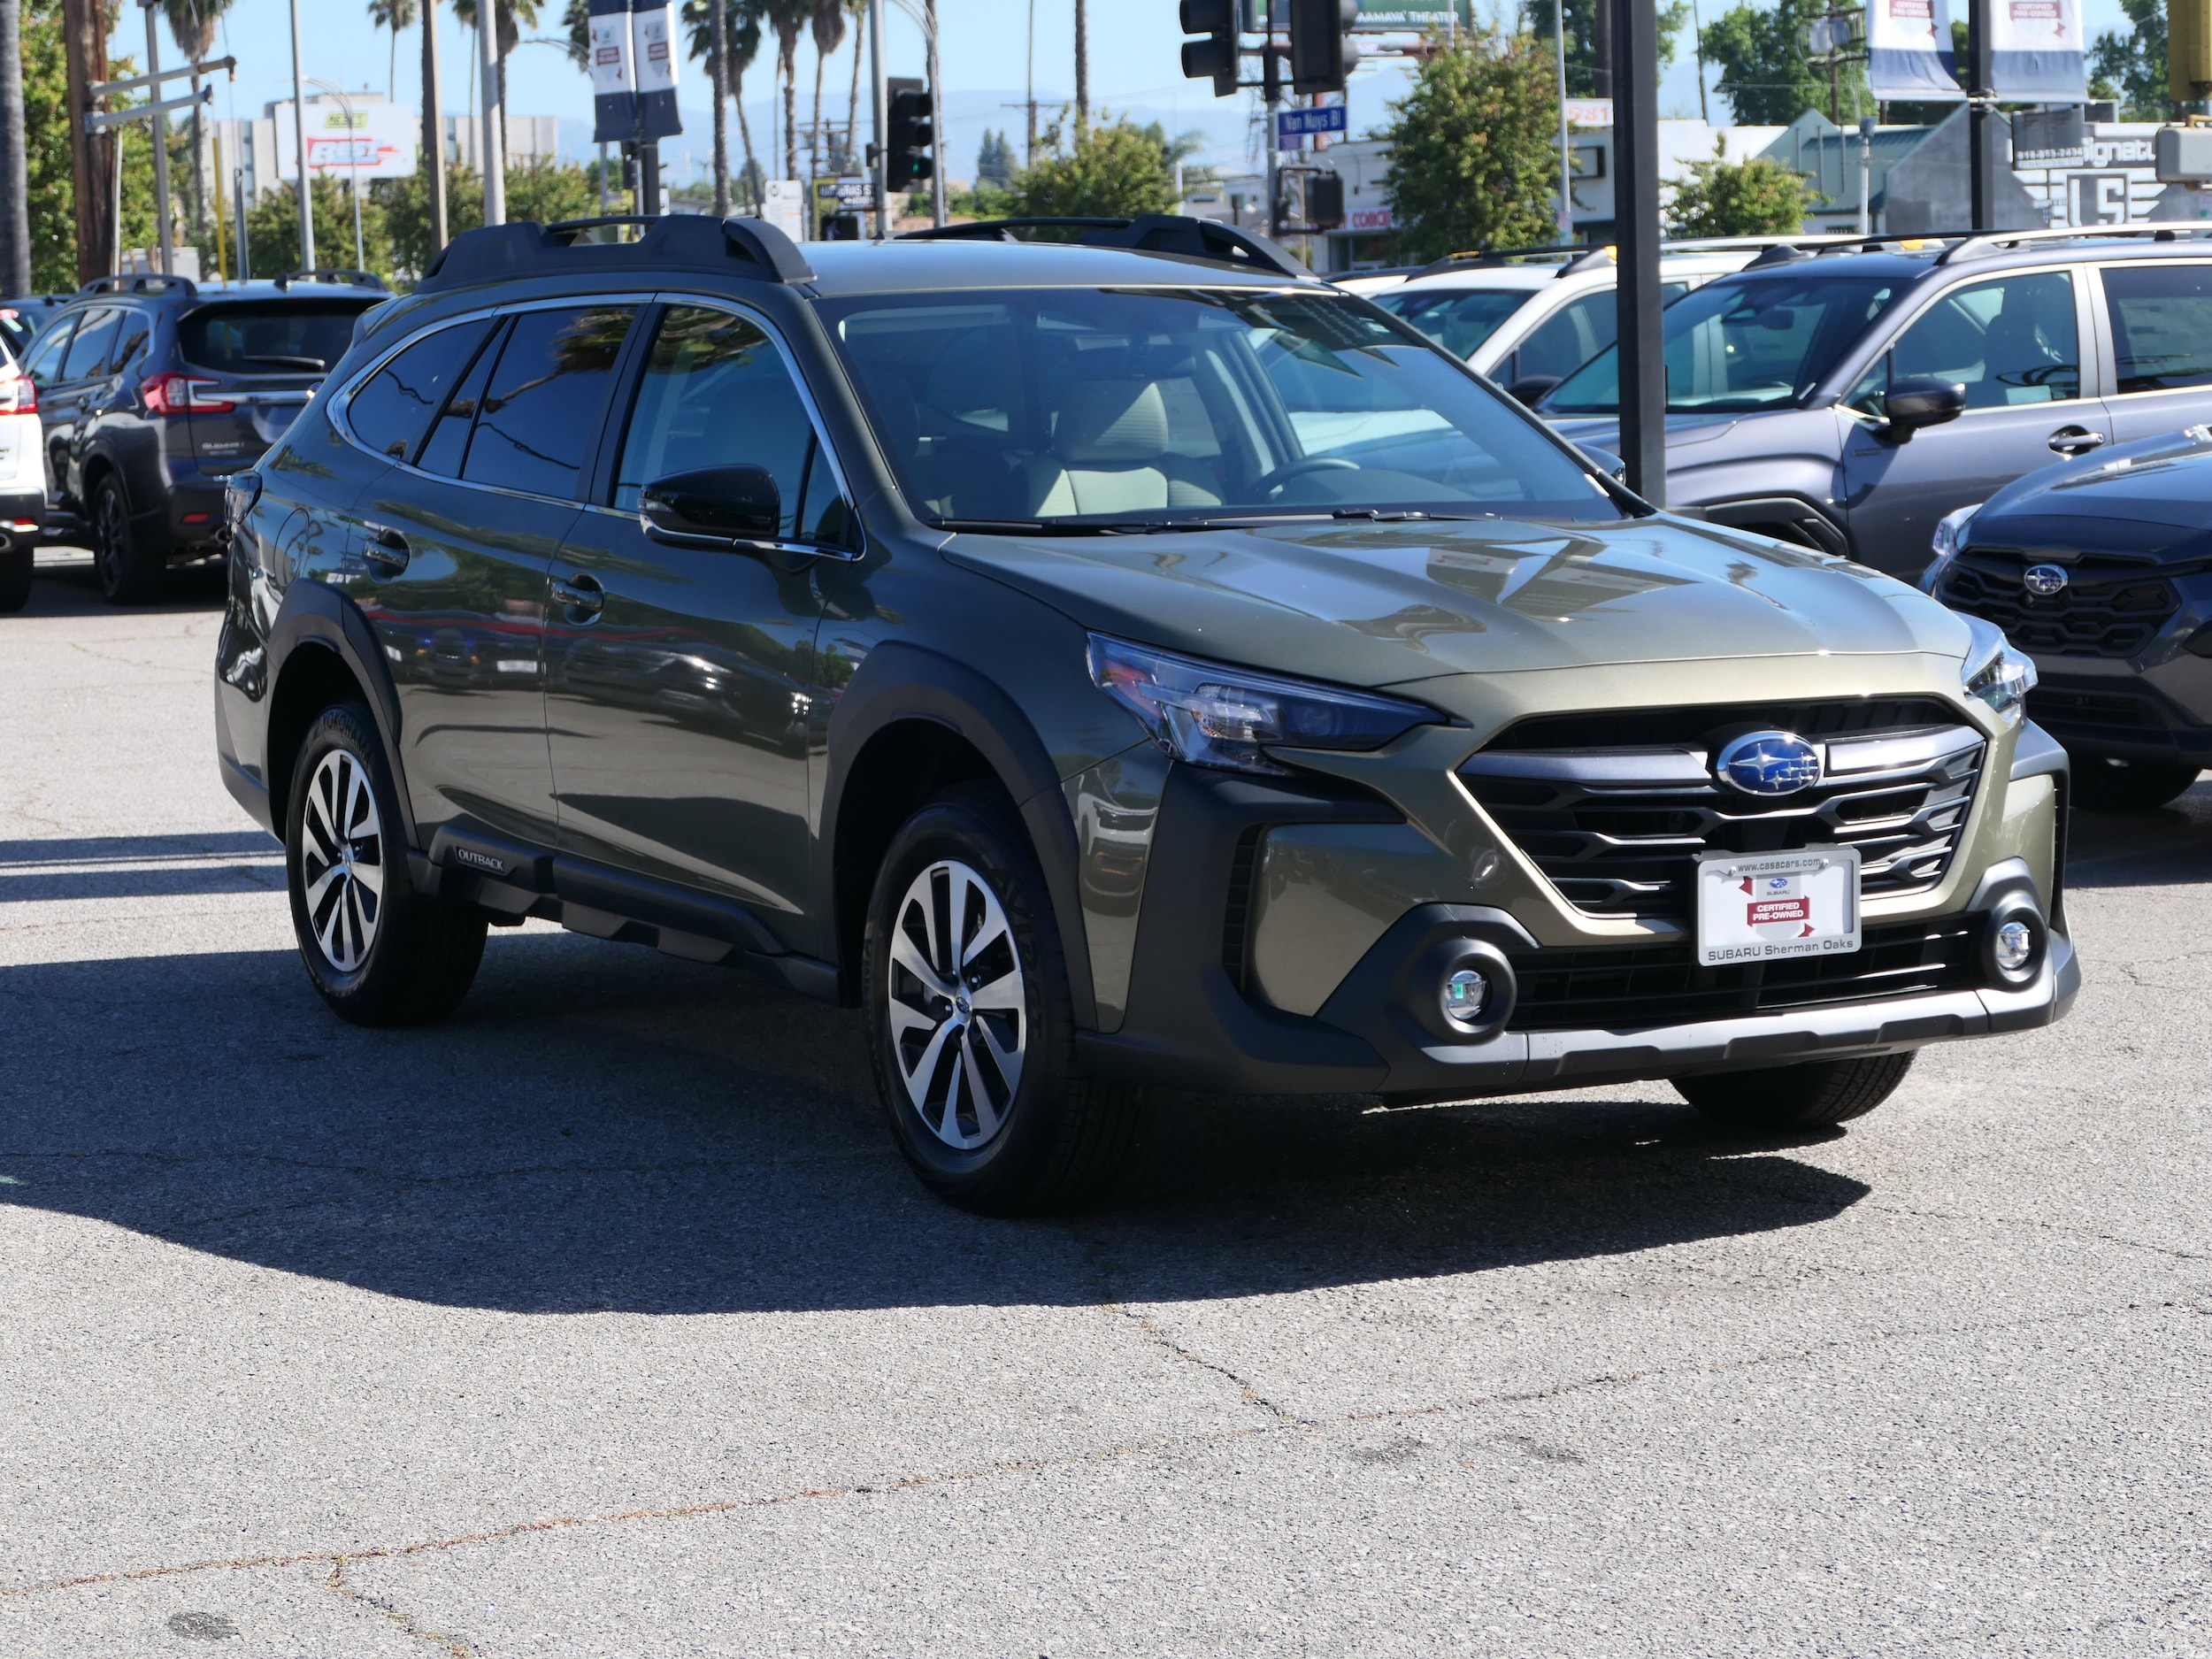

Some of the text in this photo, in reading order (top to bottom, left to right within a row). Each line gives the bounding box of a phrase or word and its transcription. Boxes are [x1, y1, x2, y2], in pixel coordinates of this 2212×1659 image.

[1355, 10, 1407, 23] AAMAVA'
[1286, 109, 1341, 132] Van Nuys Bl
[457, 849, 505, 872] OUTBACK
[1737, 858, 1821, 872] www.casacars.com
[1756, 902, 1801, 913] CERTIFIED
[1752, 910, 1804, 921] PRE-OWNED
[1708, 940, 1854, 962] SUBARU Sherman Oaks
